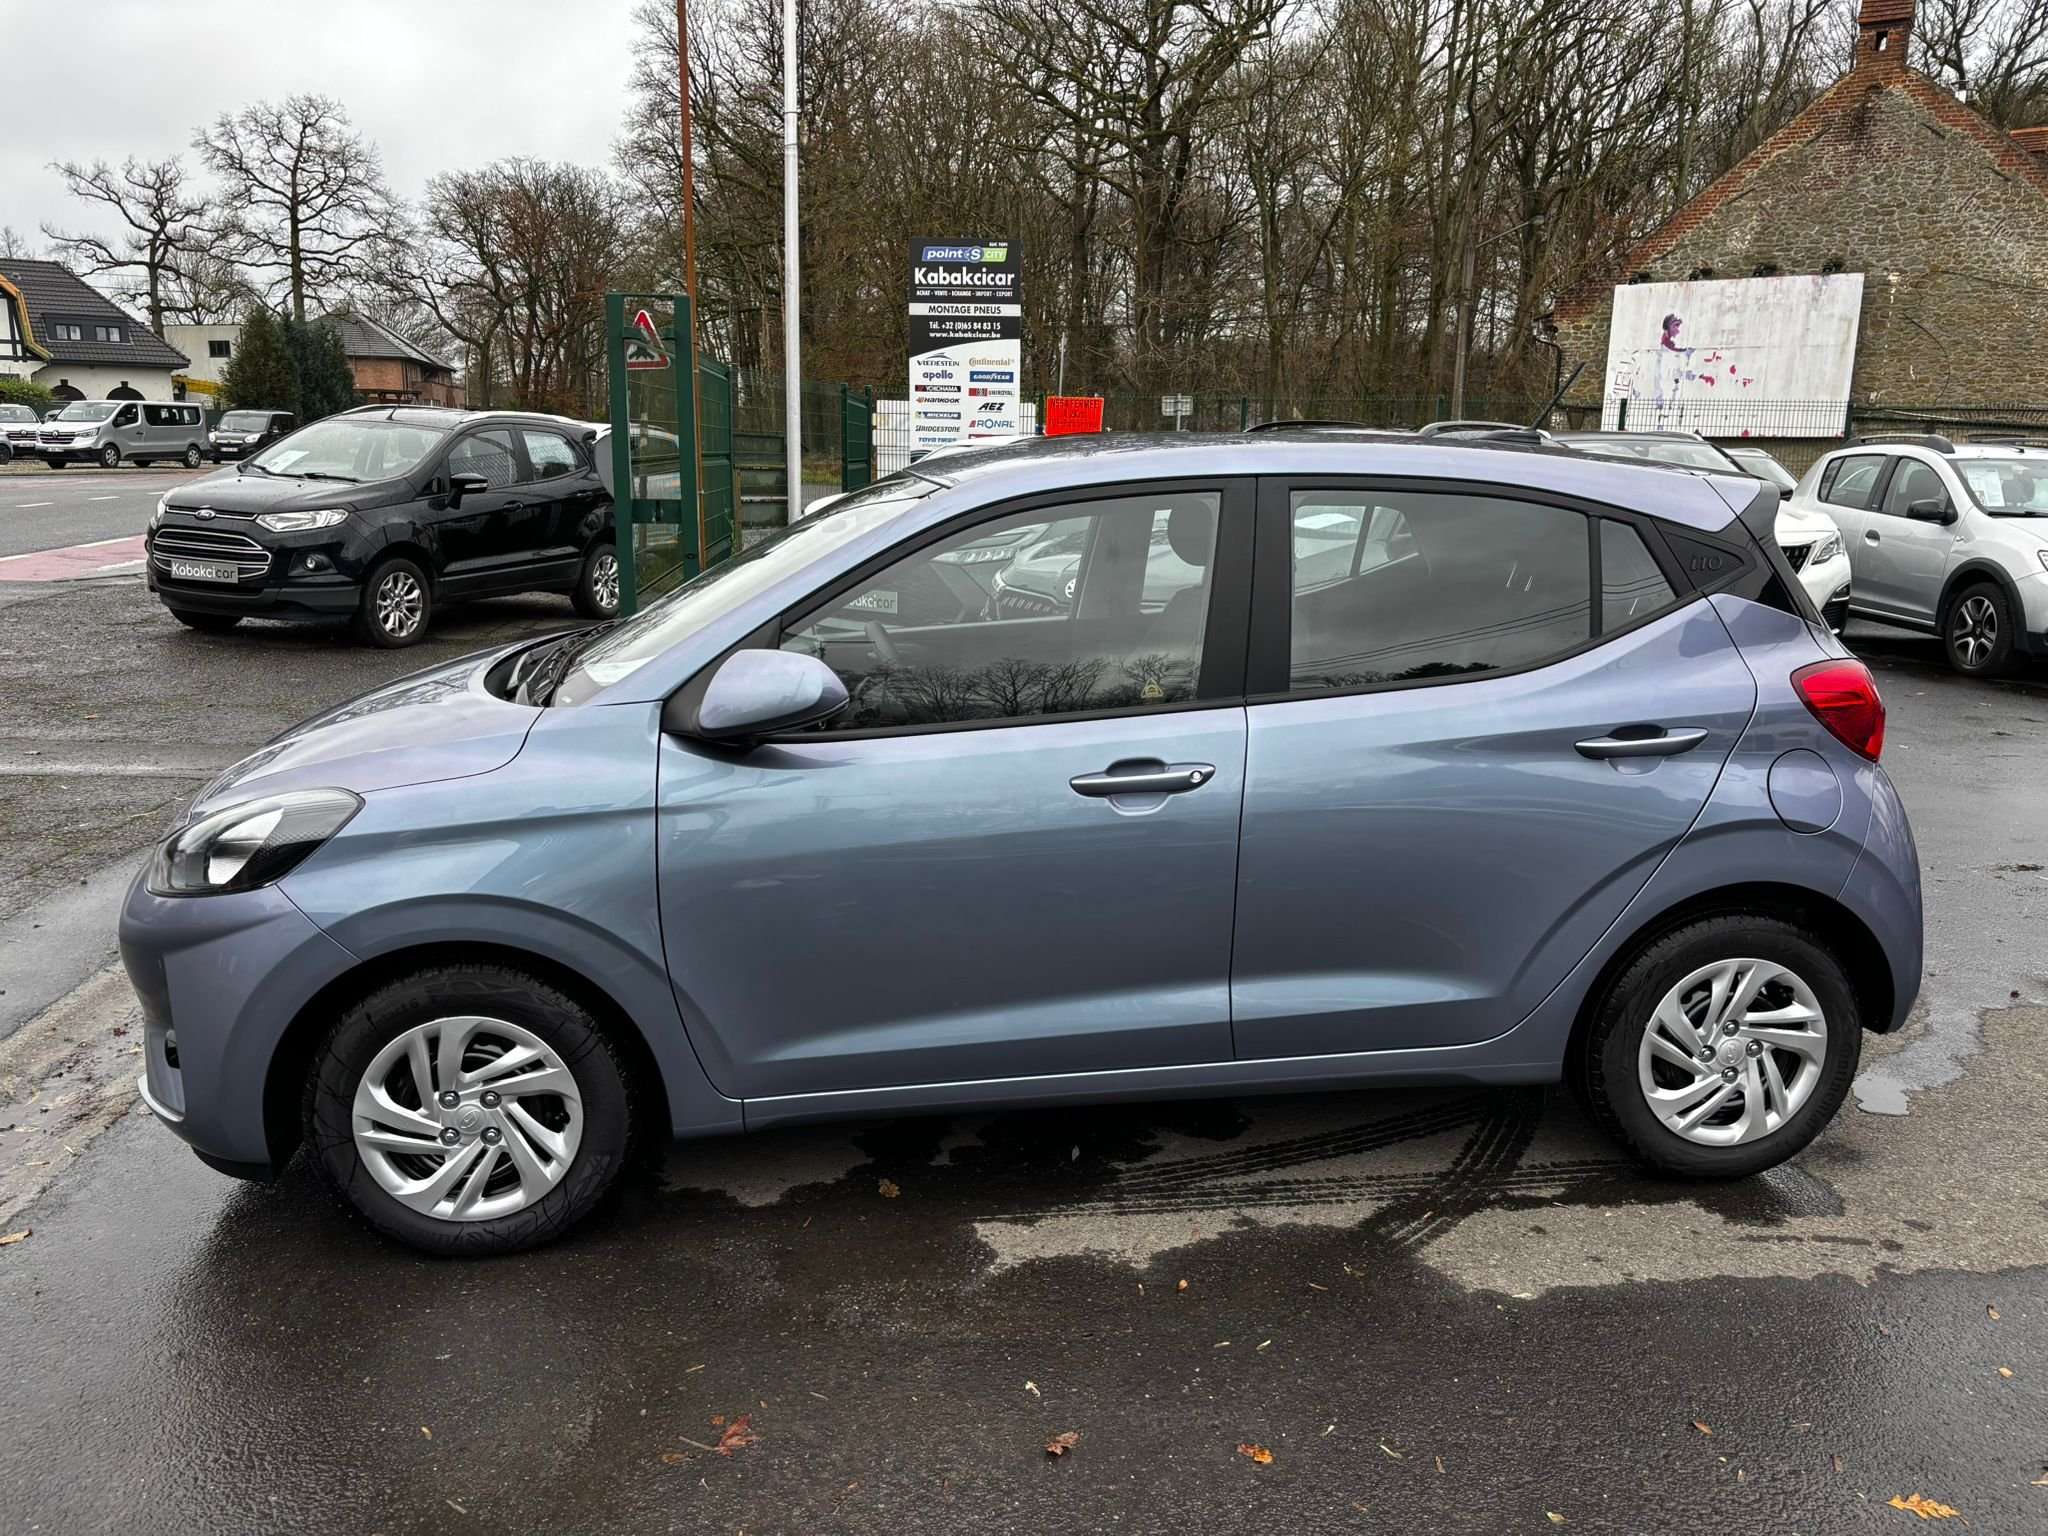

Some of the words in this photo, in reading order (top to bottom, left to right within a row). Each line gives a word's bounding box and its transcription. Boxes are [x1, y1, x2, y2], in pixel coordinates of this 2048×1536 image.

[927, 248, 963, 260] point
[914, 266, 1015, 286] Kabakcicar
[928, 305, 971, 314] MONTAGE
[973, 306, 1002, 315] PNEUS
[941, 322, 954, 330] +32
[955, 321, 972, 331] (0)65
[973, 322, 981, 330] 84
[993, 322, 1001, 330] 15
[968, 357, 1011, 367] Continental
[922, 370, 954, 381] apollo
[978, 402, 1005, 411] AEZ
[915, 425, 961, 433] BRIDGESTONE
[977, 419, 1015, 429] RONAL
[171, 562, 236, 579] Kabakcicar
